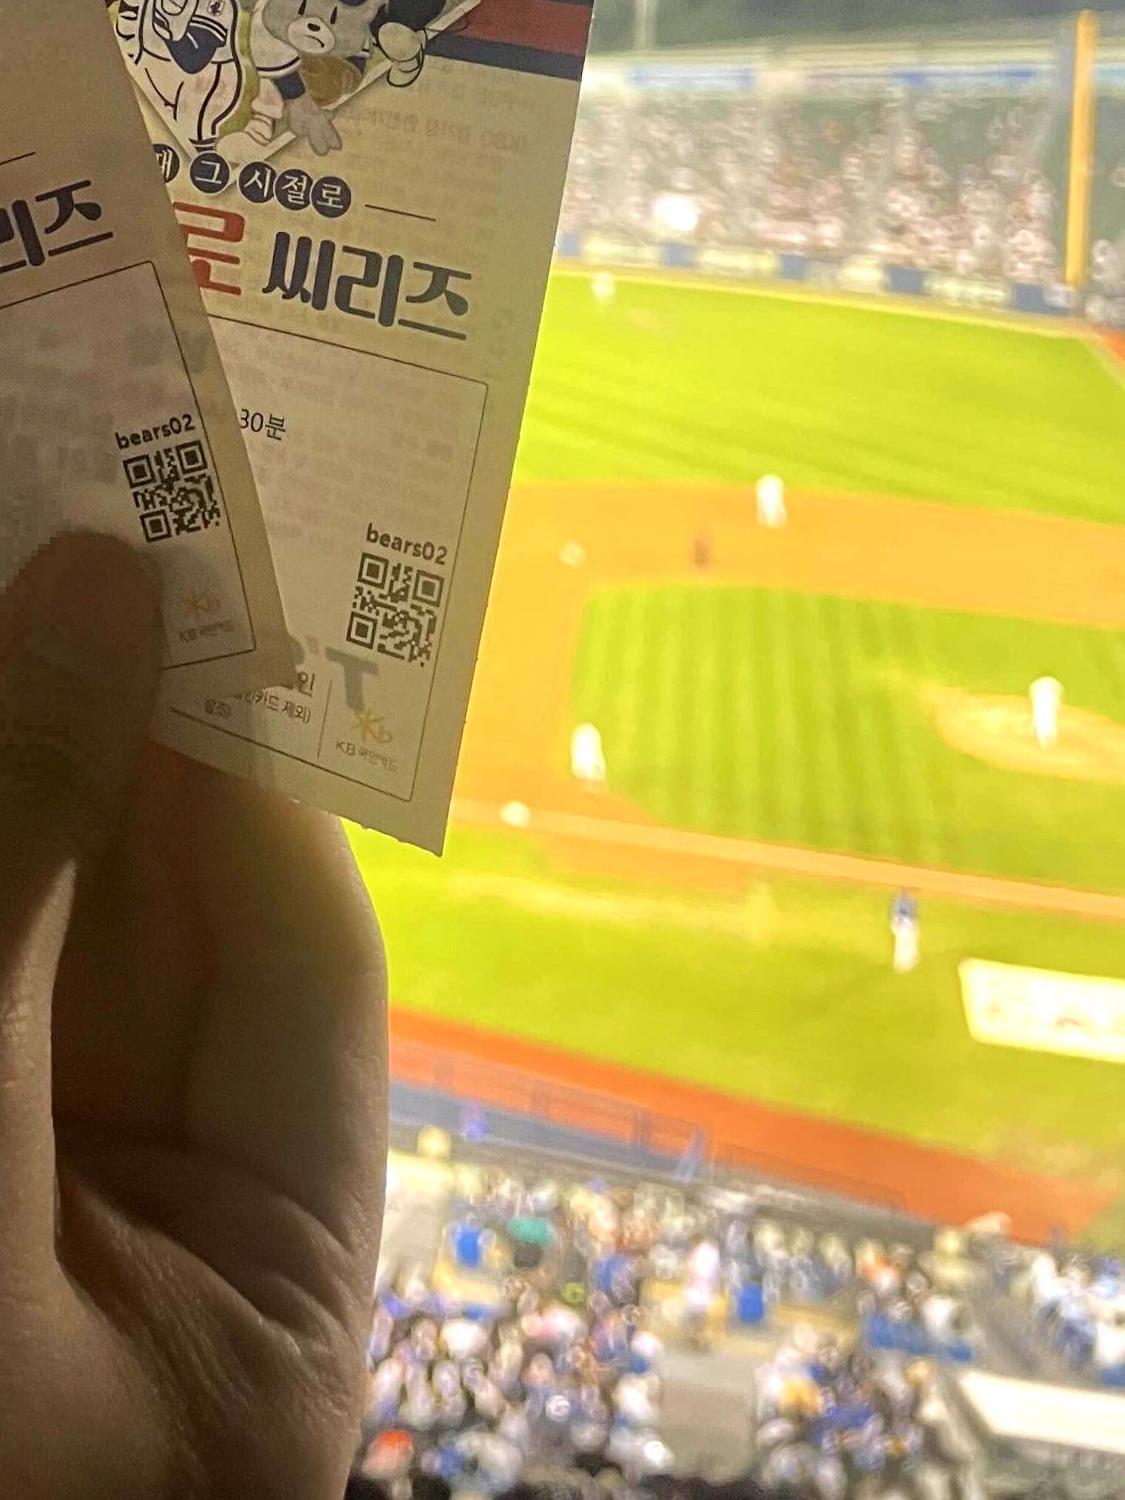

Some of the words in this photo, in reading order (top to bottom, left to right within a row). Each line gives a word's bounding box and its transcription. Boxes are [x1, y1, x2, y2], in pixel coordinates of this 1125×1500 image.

[192, 157, 225, 188] 그
[242, 165, 346, 211] 시절로
[262, 231, 472, 340] 씨리즈
[115, 413, 196, 450] bears02
[367, 522, 449, 567] bears02
